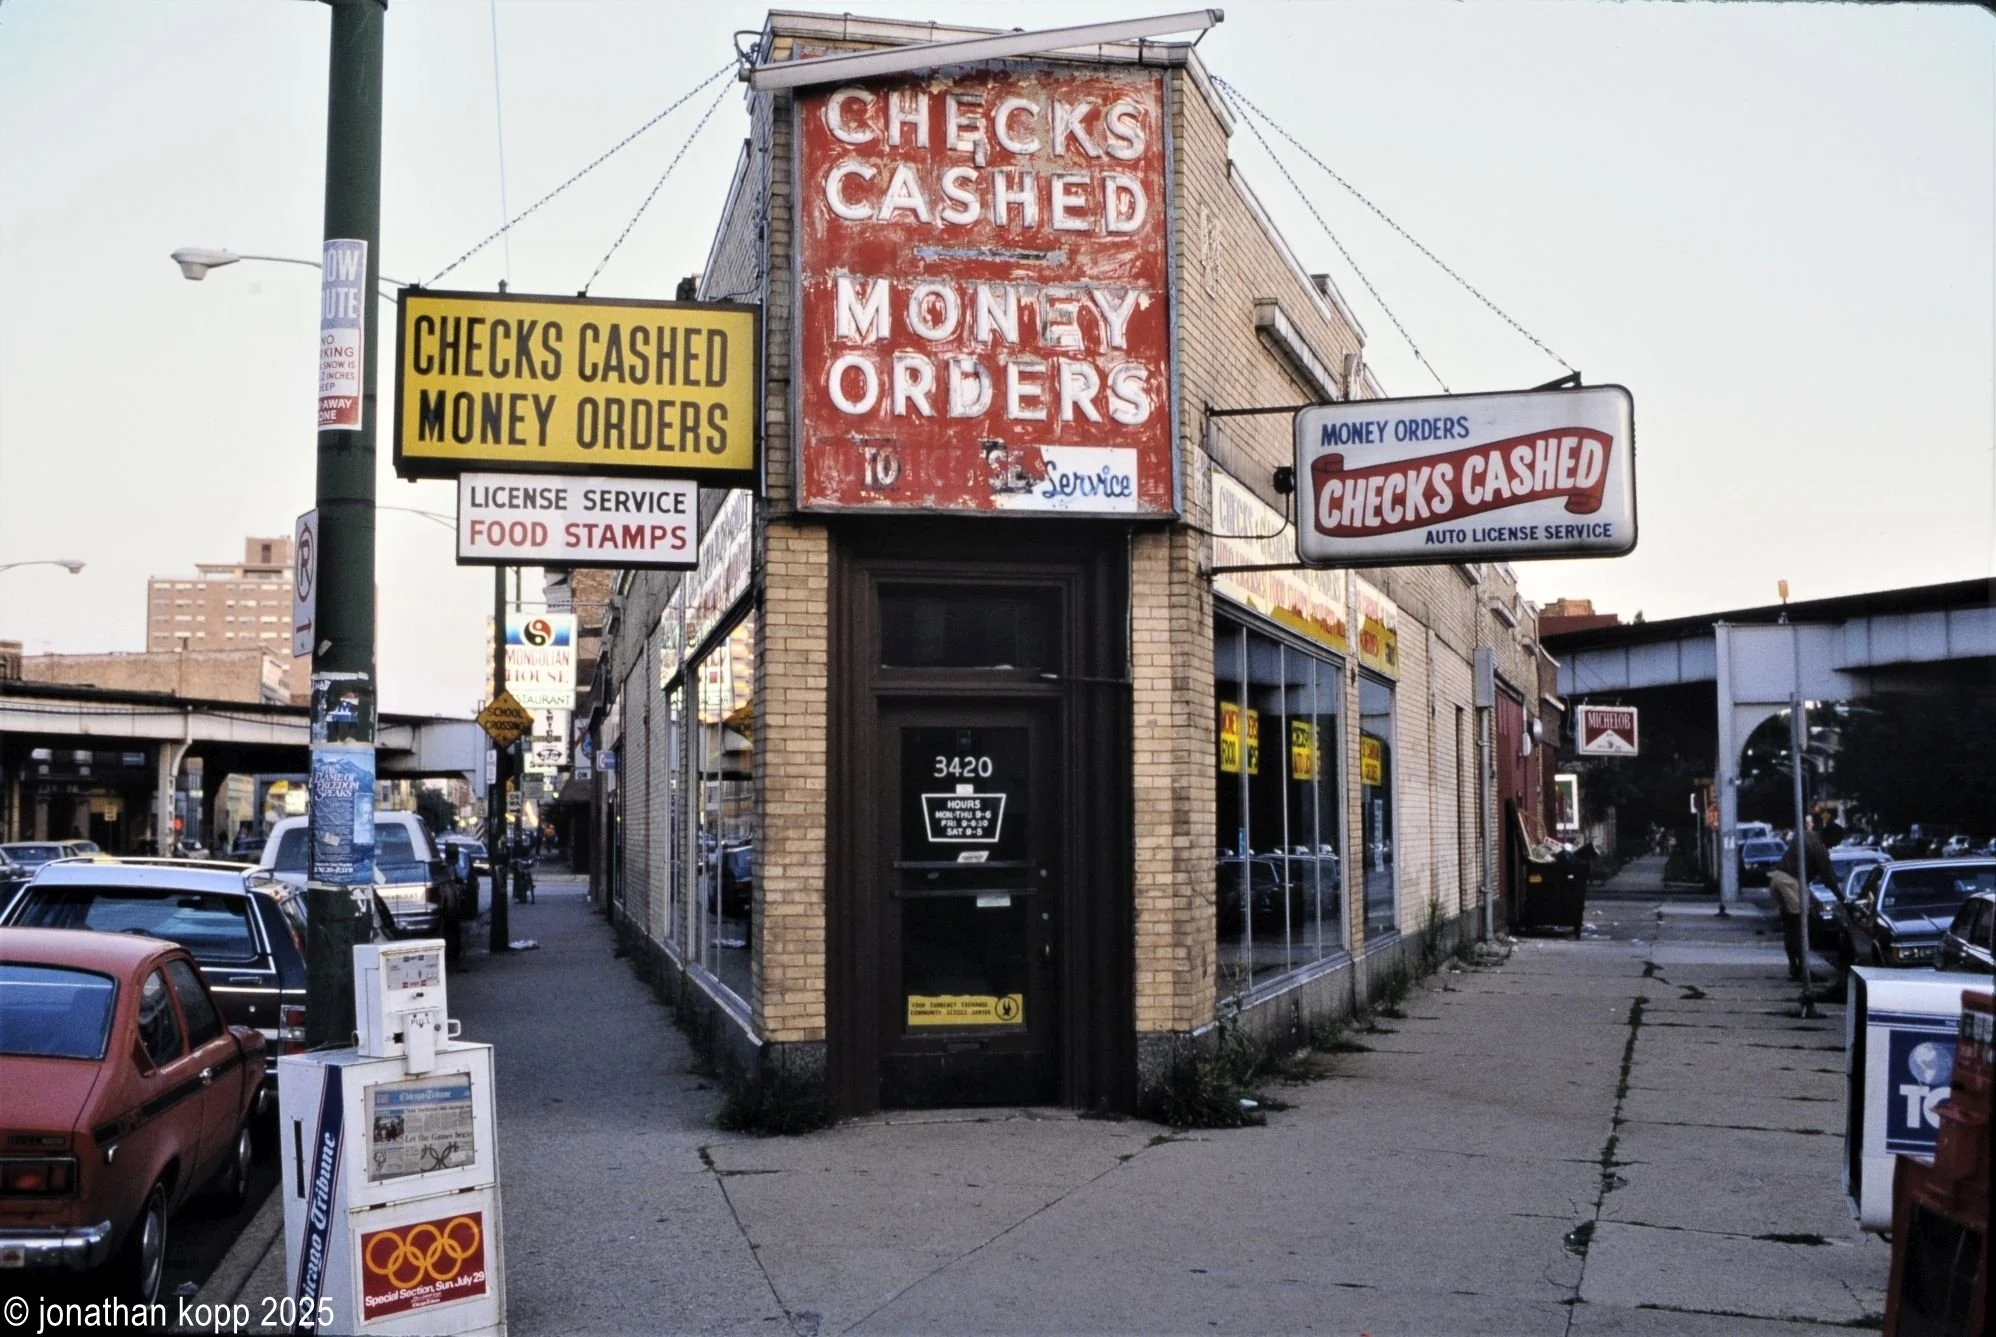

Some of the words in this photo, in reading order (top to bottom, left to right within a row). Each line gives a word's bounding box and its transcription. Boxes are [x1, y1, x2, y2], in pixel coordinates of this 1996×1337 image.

[824, 86, 1147, 161] CHECKS
[824, 159, 1148, 235] CASHED
[835, 275, 1141, 351] MONEY
[413, 313, 563, 382] CHECKS
[577, 321, 729, 388] CASHED
[828, 352, 1152, 425] ORDERS
[418, 388, 557, 447] MONEY
[576, 396, 729, 455] ORDERS
[1320, 419, 1389, 447] MONEY
[1394, 416, 1470, 443] ORDERS
[1042, 459, 1133, 499] Service
[1318, 462, 1455, 530] CHECKS
[1461, 435, 1604, 506] CASHED
[470, 485, 568, 511] LICENSE
[583, 489, 687, 514] SERVICE
[470, 519, 548, 547] FOOD
[565, 522, 687, 550] STAMPS
[1424, 527, 1468, 545] AUTO
[1472, 524, 1539, 543] LICENSE
[1543, 522, 1612, 541] SERVICE
[487, 706, 523, 718] SCHOOL
[517, 694, 570, 705] STAURANT
[1588, 711, 1631, 729] MICHELOB
[934, 756, 993, 777] 3420
[947, 800, 981, 809] HOURS
[946, 828, 963, 836] SAT
[965, 828, 983, 836] 9-5
[311, 1131, 337, 1231] Tribune
[365, 1290, 399, 1308] Special
[455, 1274, 473, 1288] July
[473, 1271, 484, 1283] 29
